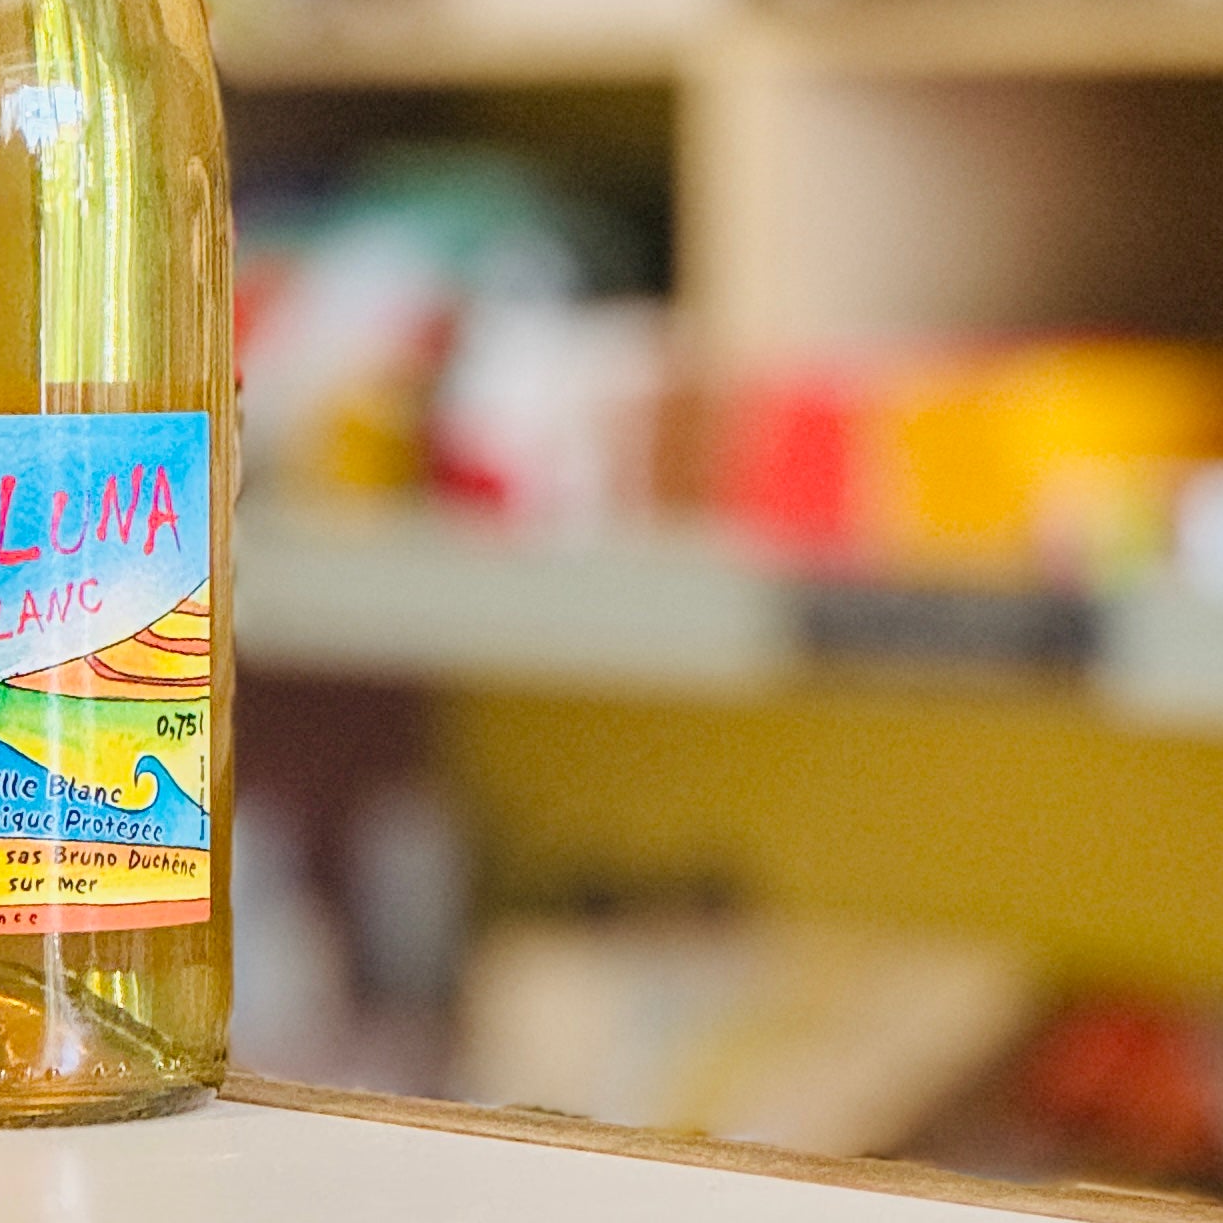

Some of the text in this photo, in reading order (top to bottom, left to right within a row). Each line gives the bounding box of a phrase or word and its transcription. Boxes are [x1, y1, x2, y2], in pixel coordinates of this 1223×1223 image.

[50, 774, 123, 805] Blanc
[66, 809, 163, 842] Protégée
[6, 849, 42, 865] sas
[54, 846, 118, 868] Bruno
[128, 849, 198, 878] Duchêne
[9, 877, 45, 892] sur
[58, 876, 98, 894] mer
